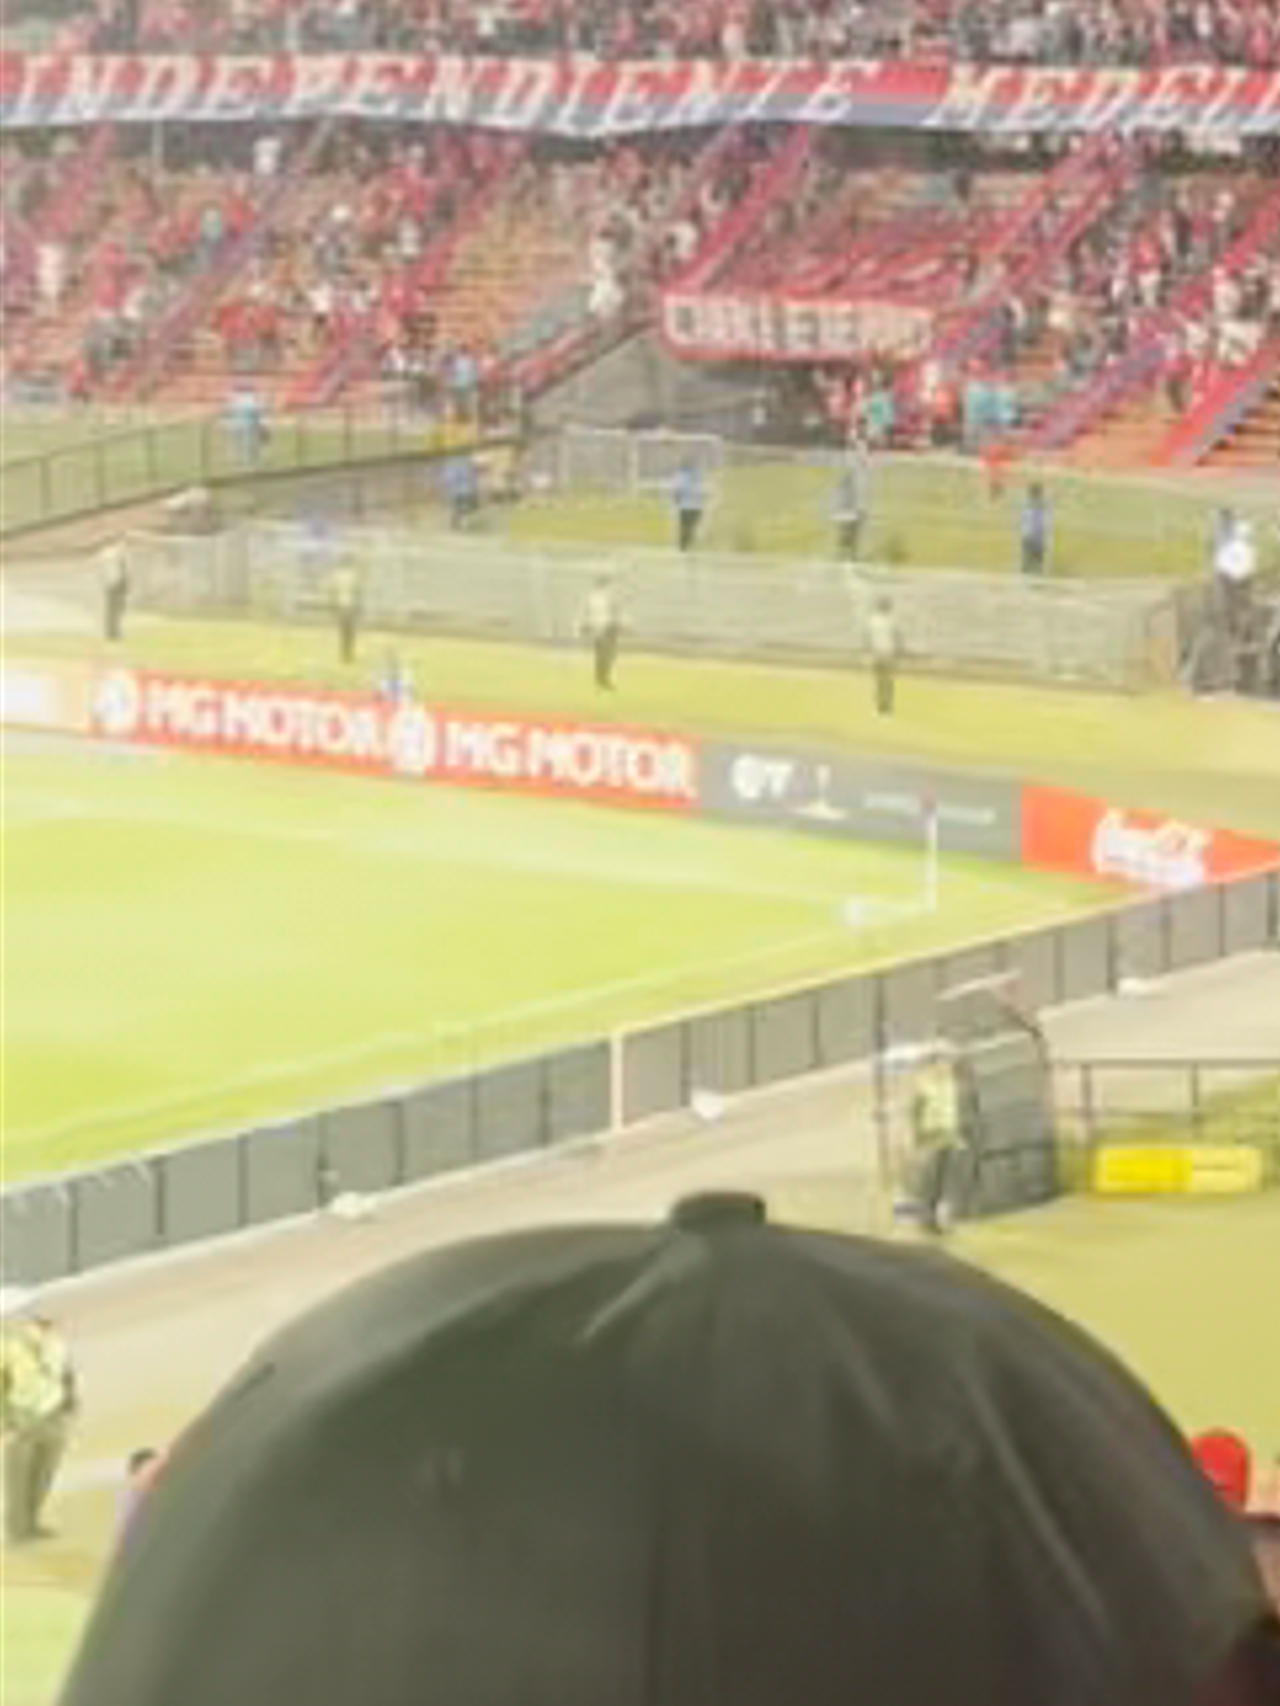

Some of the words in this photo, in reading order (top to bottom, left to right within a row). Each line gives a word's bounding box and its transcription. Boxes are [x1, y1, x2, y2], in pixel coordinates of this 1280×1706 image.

[5, 53, 880, 136] INDEPENDIENTE
[148, 681, 222, 736] MG
[447, 722, 525, 776] MG
[529, 731, 698, 800] MOTOR
